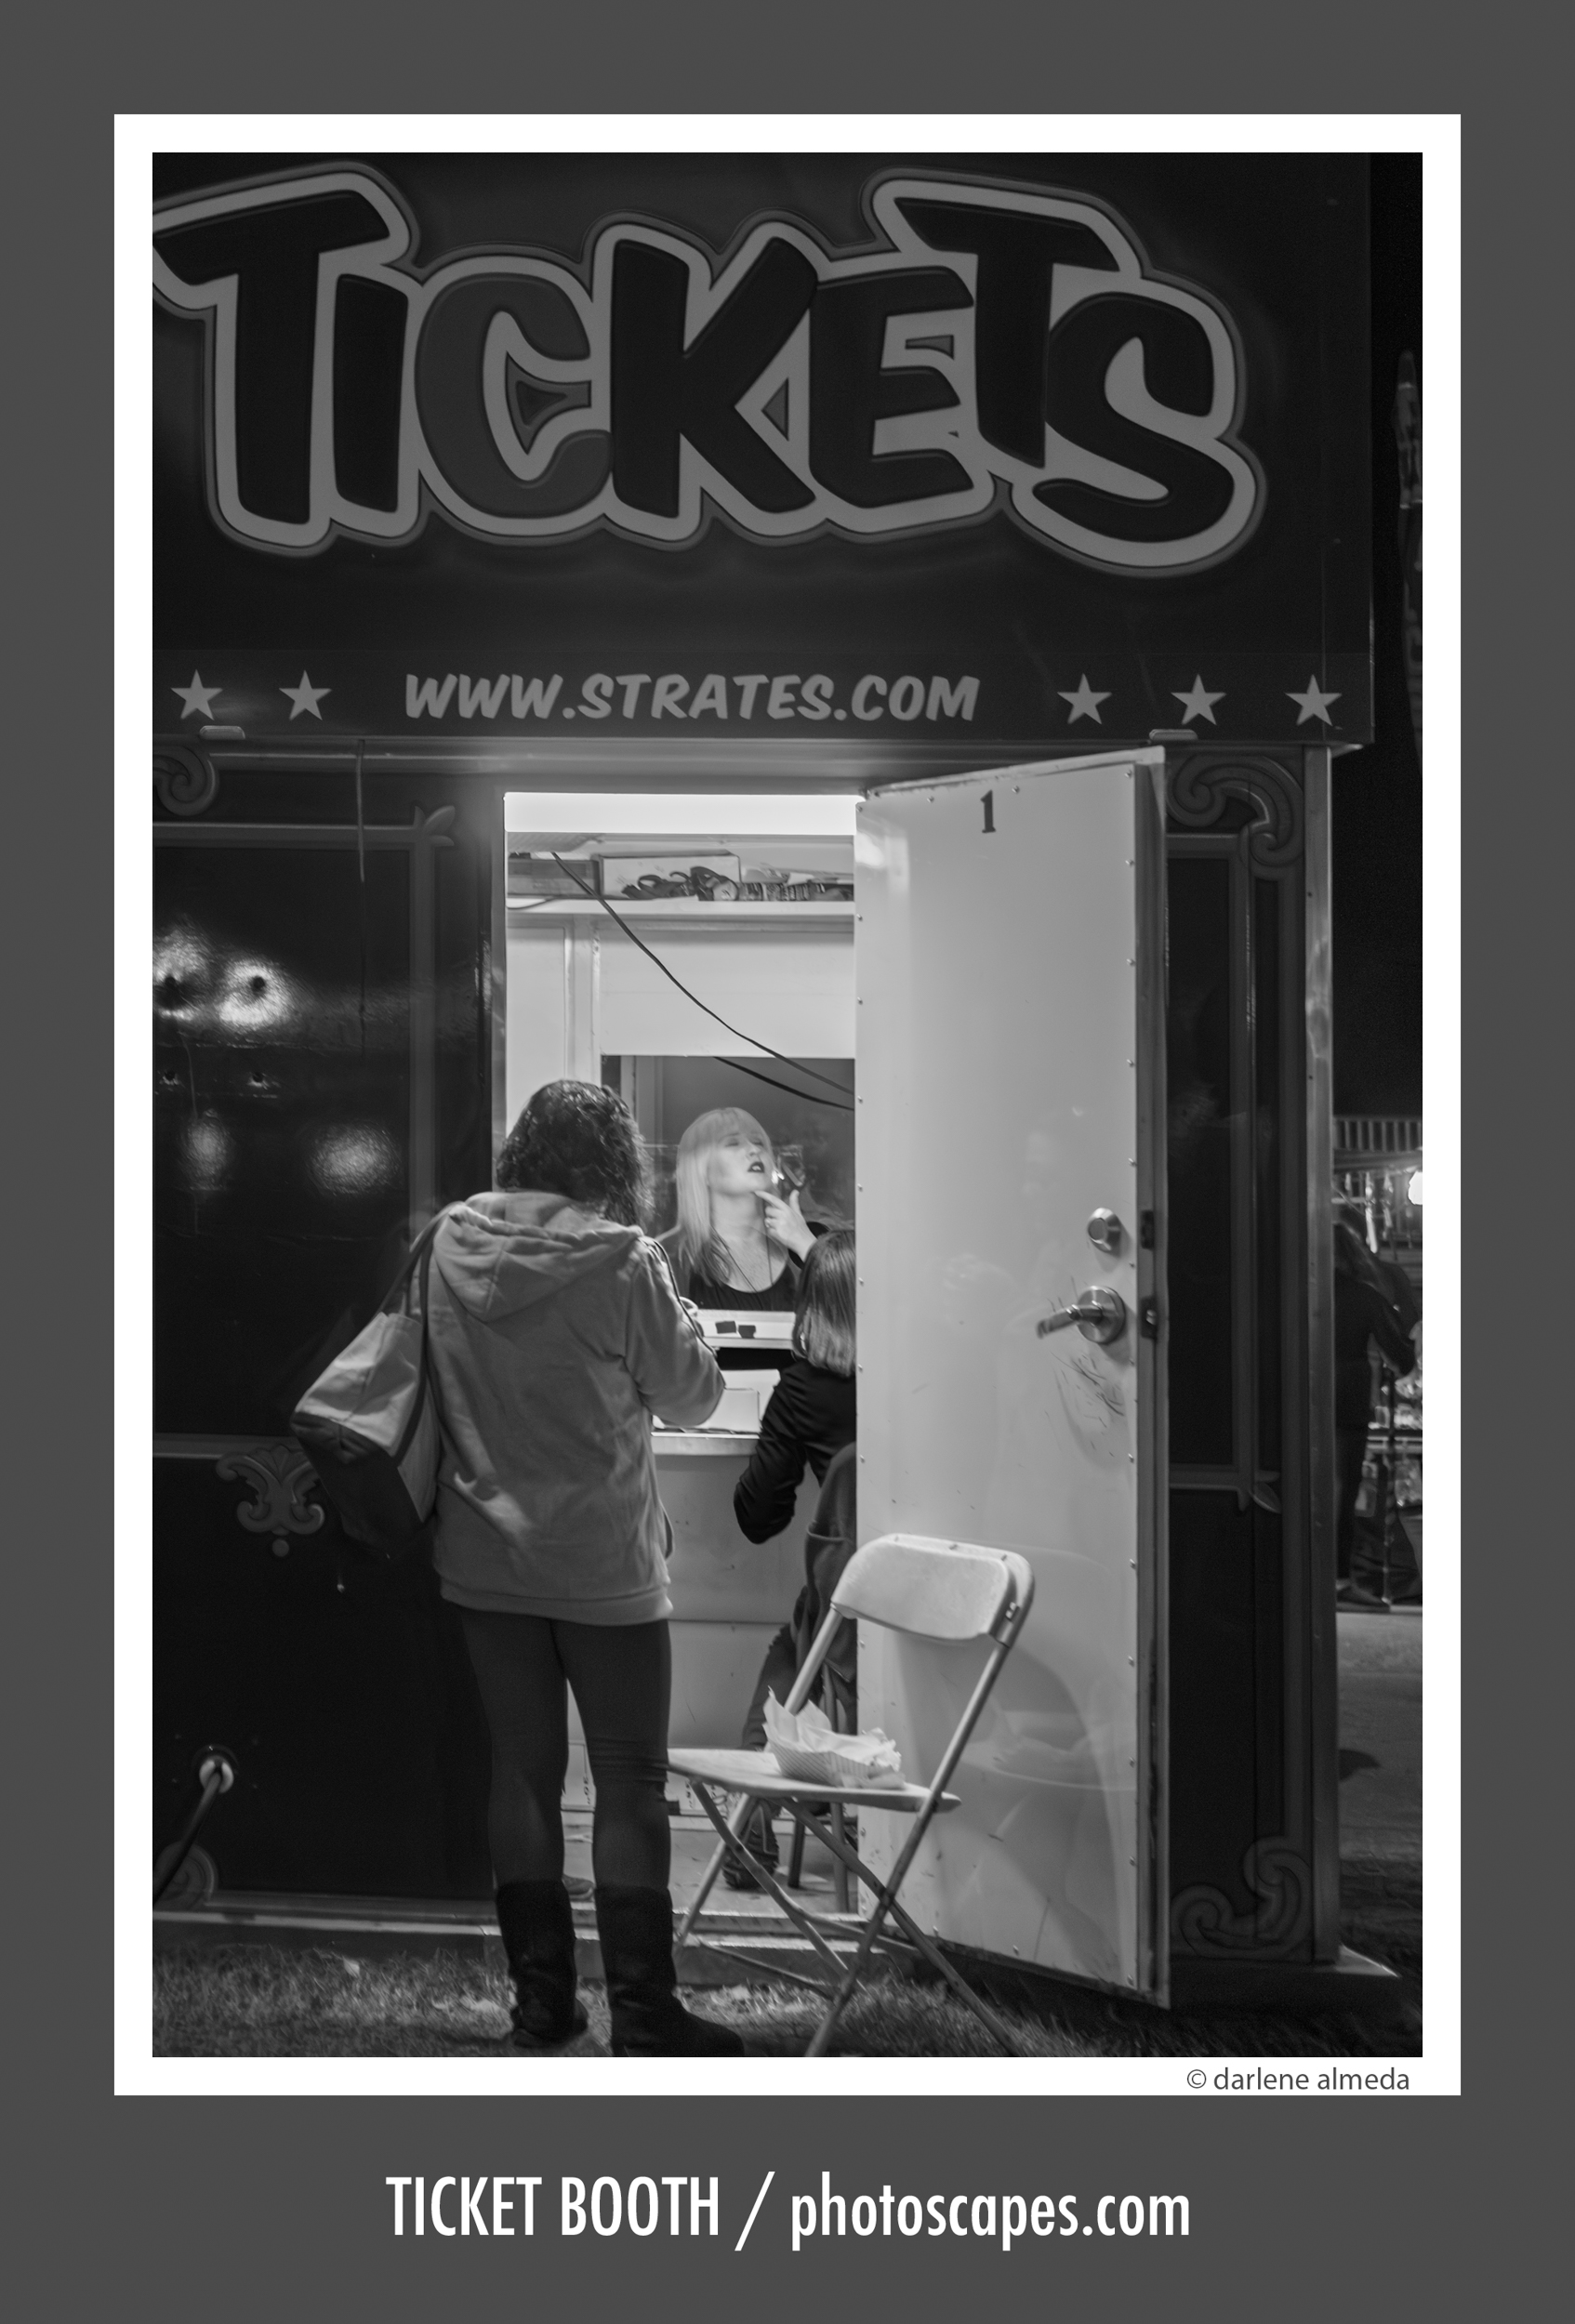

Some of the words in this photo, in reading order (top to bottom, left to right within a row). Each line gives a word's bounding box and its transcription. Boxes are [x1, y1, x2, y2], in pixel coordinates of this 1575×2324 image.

[152, 172, 1257, 566] TICKETS
[405, 672, 980, 721] WWW.STRATES.COM
[981, 790, 996, 834] 1
